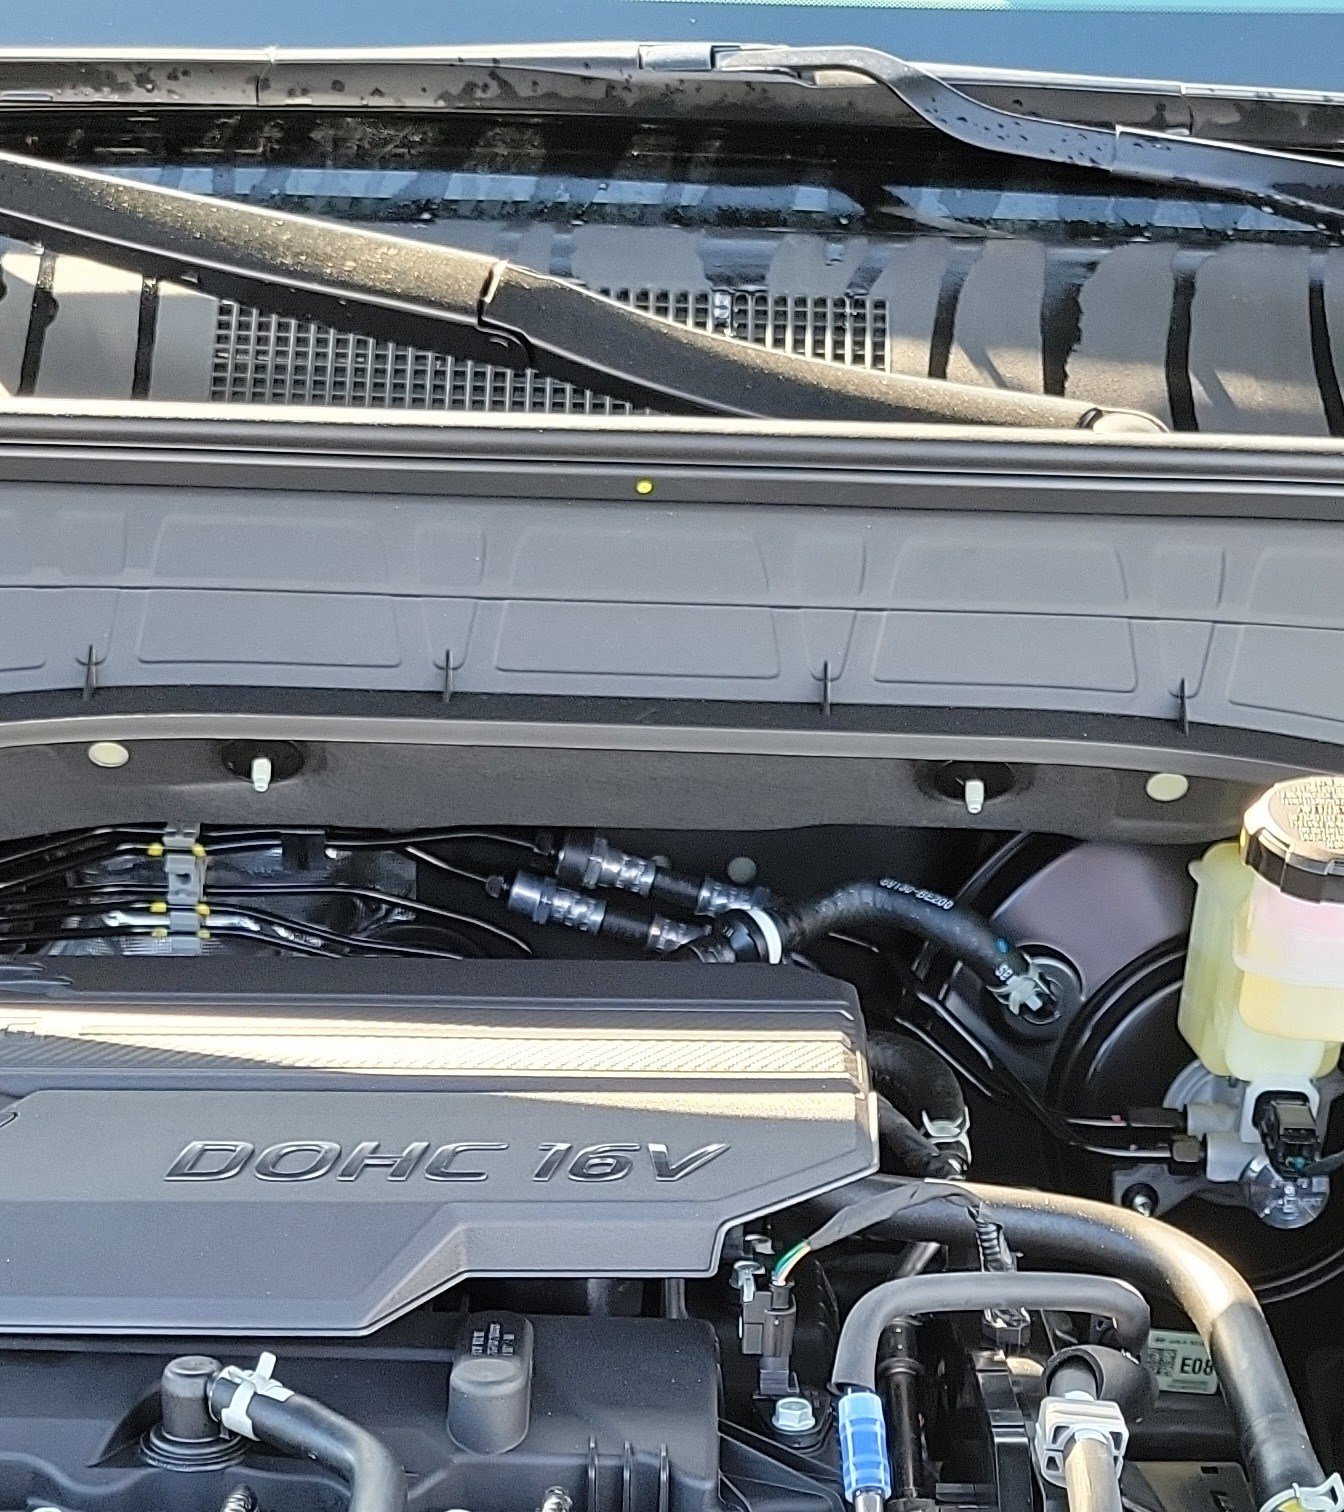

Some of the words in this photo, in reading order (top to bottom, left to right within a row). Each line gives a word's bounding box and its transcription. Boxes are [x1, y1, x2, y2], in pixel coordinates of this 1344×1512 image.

[163, 1140, 510, 1182] DOHC
[531, 1141, 732, 1182] 16V
[1180, 1357, 1213, 1376] E08
